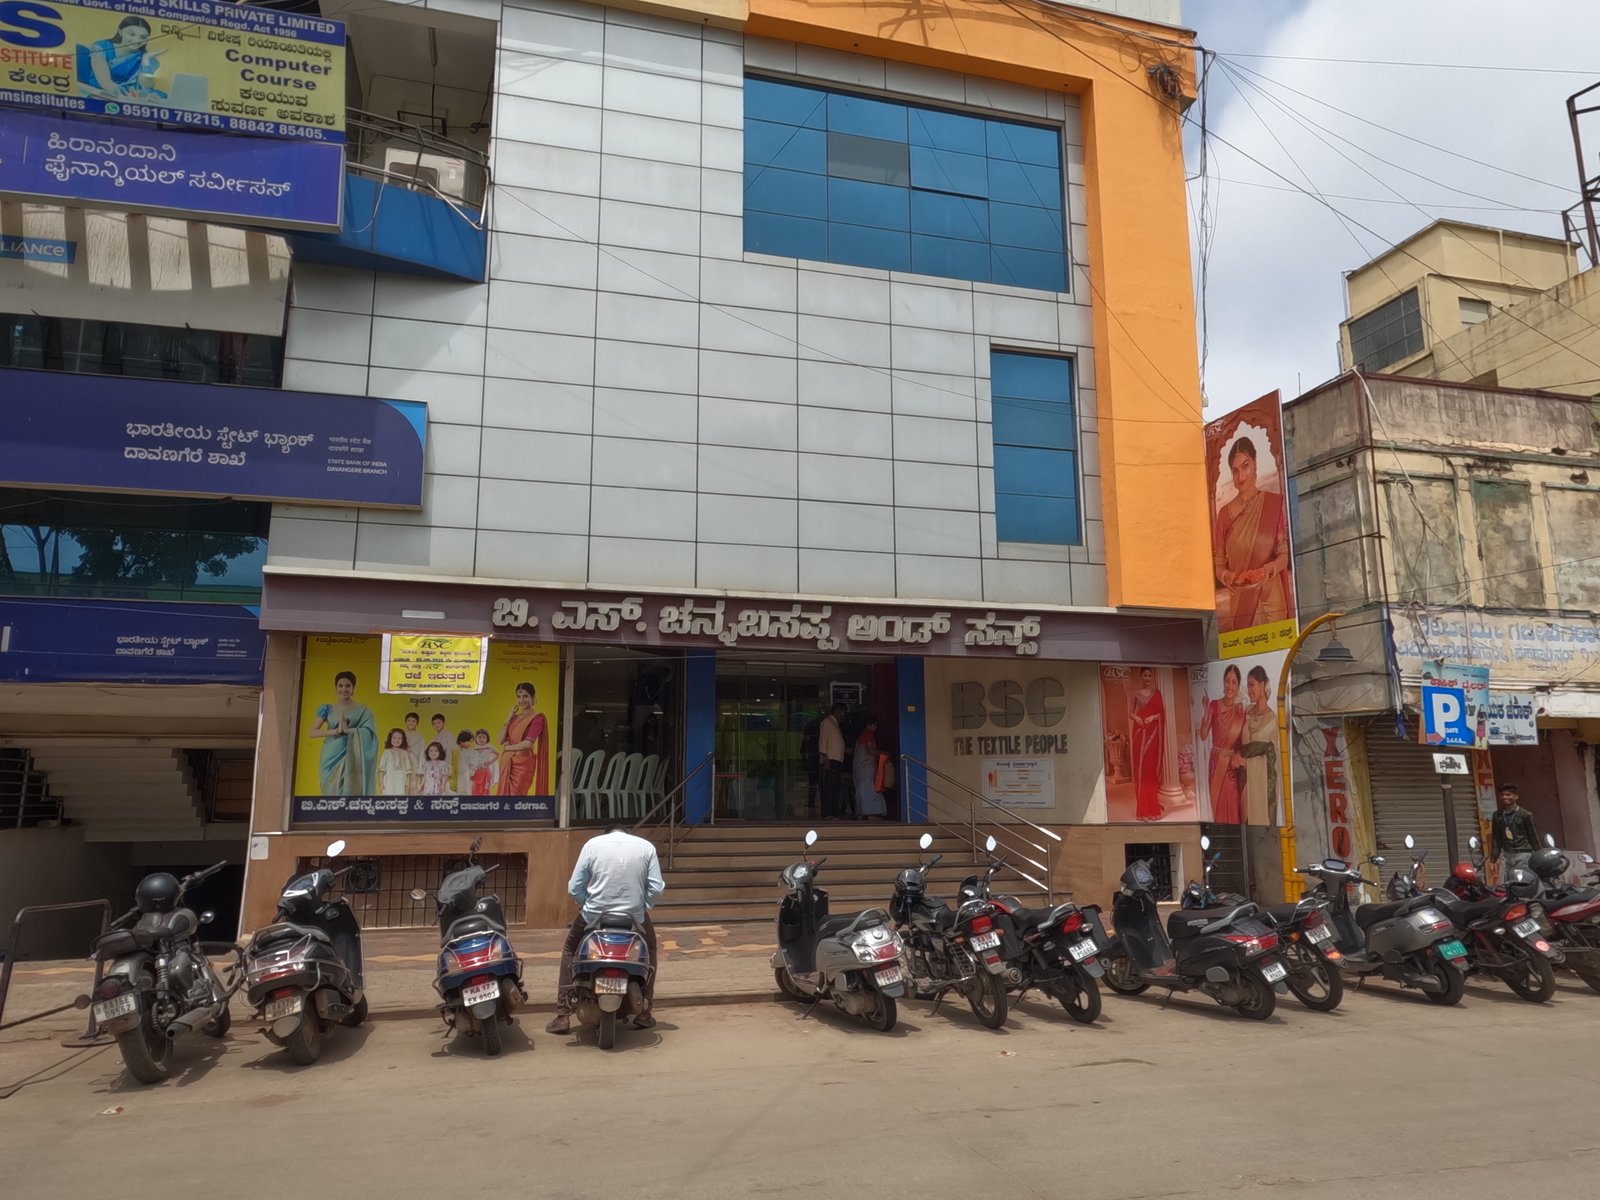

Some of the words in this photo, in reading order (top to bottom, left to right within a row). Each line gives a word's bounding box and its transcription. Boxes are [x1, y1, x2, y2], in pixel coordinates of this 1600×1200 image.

[128, 4, 155, 15] India
[158, 8, 218, 25] Companies
[253, 24, 271, 34] Act
[273, 27, 298, 38] 1956
[159, 0, 211, 14] SKILLS
[214, 7, 275, 24] PRIVATE
[279, 15, 336, 34] LIMITED
[225, 48, 333, 76] Computer
[8, 68, 71, 93] ಕೇಂದ್ರ
[240, 68, 317, 91] Course
[239, 87, 309, 108] ಕಲಿಯುವ
[122, 103, 170, 120] 95910
[175, 110, 225, 128] 78215,
[229, 119, 275, 133] 88842
[279, 125, 327, 140] 85405.
[210, 98, 268, 117] ಸುವರ್ಣ
[276, 107, 337, 126] ಅವಕಾಶ
[47, 132, 176, 162] ಹಿರಾನಂದಾನಿ
[188, 170, 292, 197] ಸರ್ವೀಸಸ್
[126, 421, 212, 441] ಭಾರತೀಯ
[216, 426, 259, 449] ಸ್ಟೇಟ್
[264, 430, 315, 453] ಬ್ಯಾಂಕ್
[123, 444, 203, 464] ದಾವಣಗೆರೆ
[207, 450, 247, 467] ಶಾಖೆ
[846, 611, 952, 643] ಅಂಡ್
[964, 612, 1041, 656] ಸನ್ಸ್
[951, 677, 1066, 730] BSC
[1432, 693, 1461, 739] P
[977, 734, 1022, 756] TEXTILE
[1025, 733, 1068, 755] PEOPLE
[413, 799, 424, 810] &
[470, 987, 481, 995] KA
